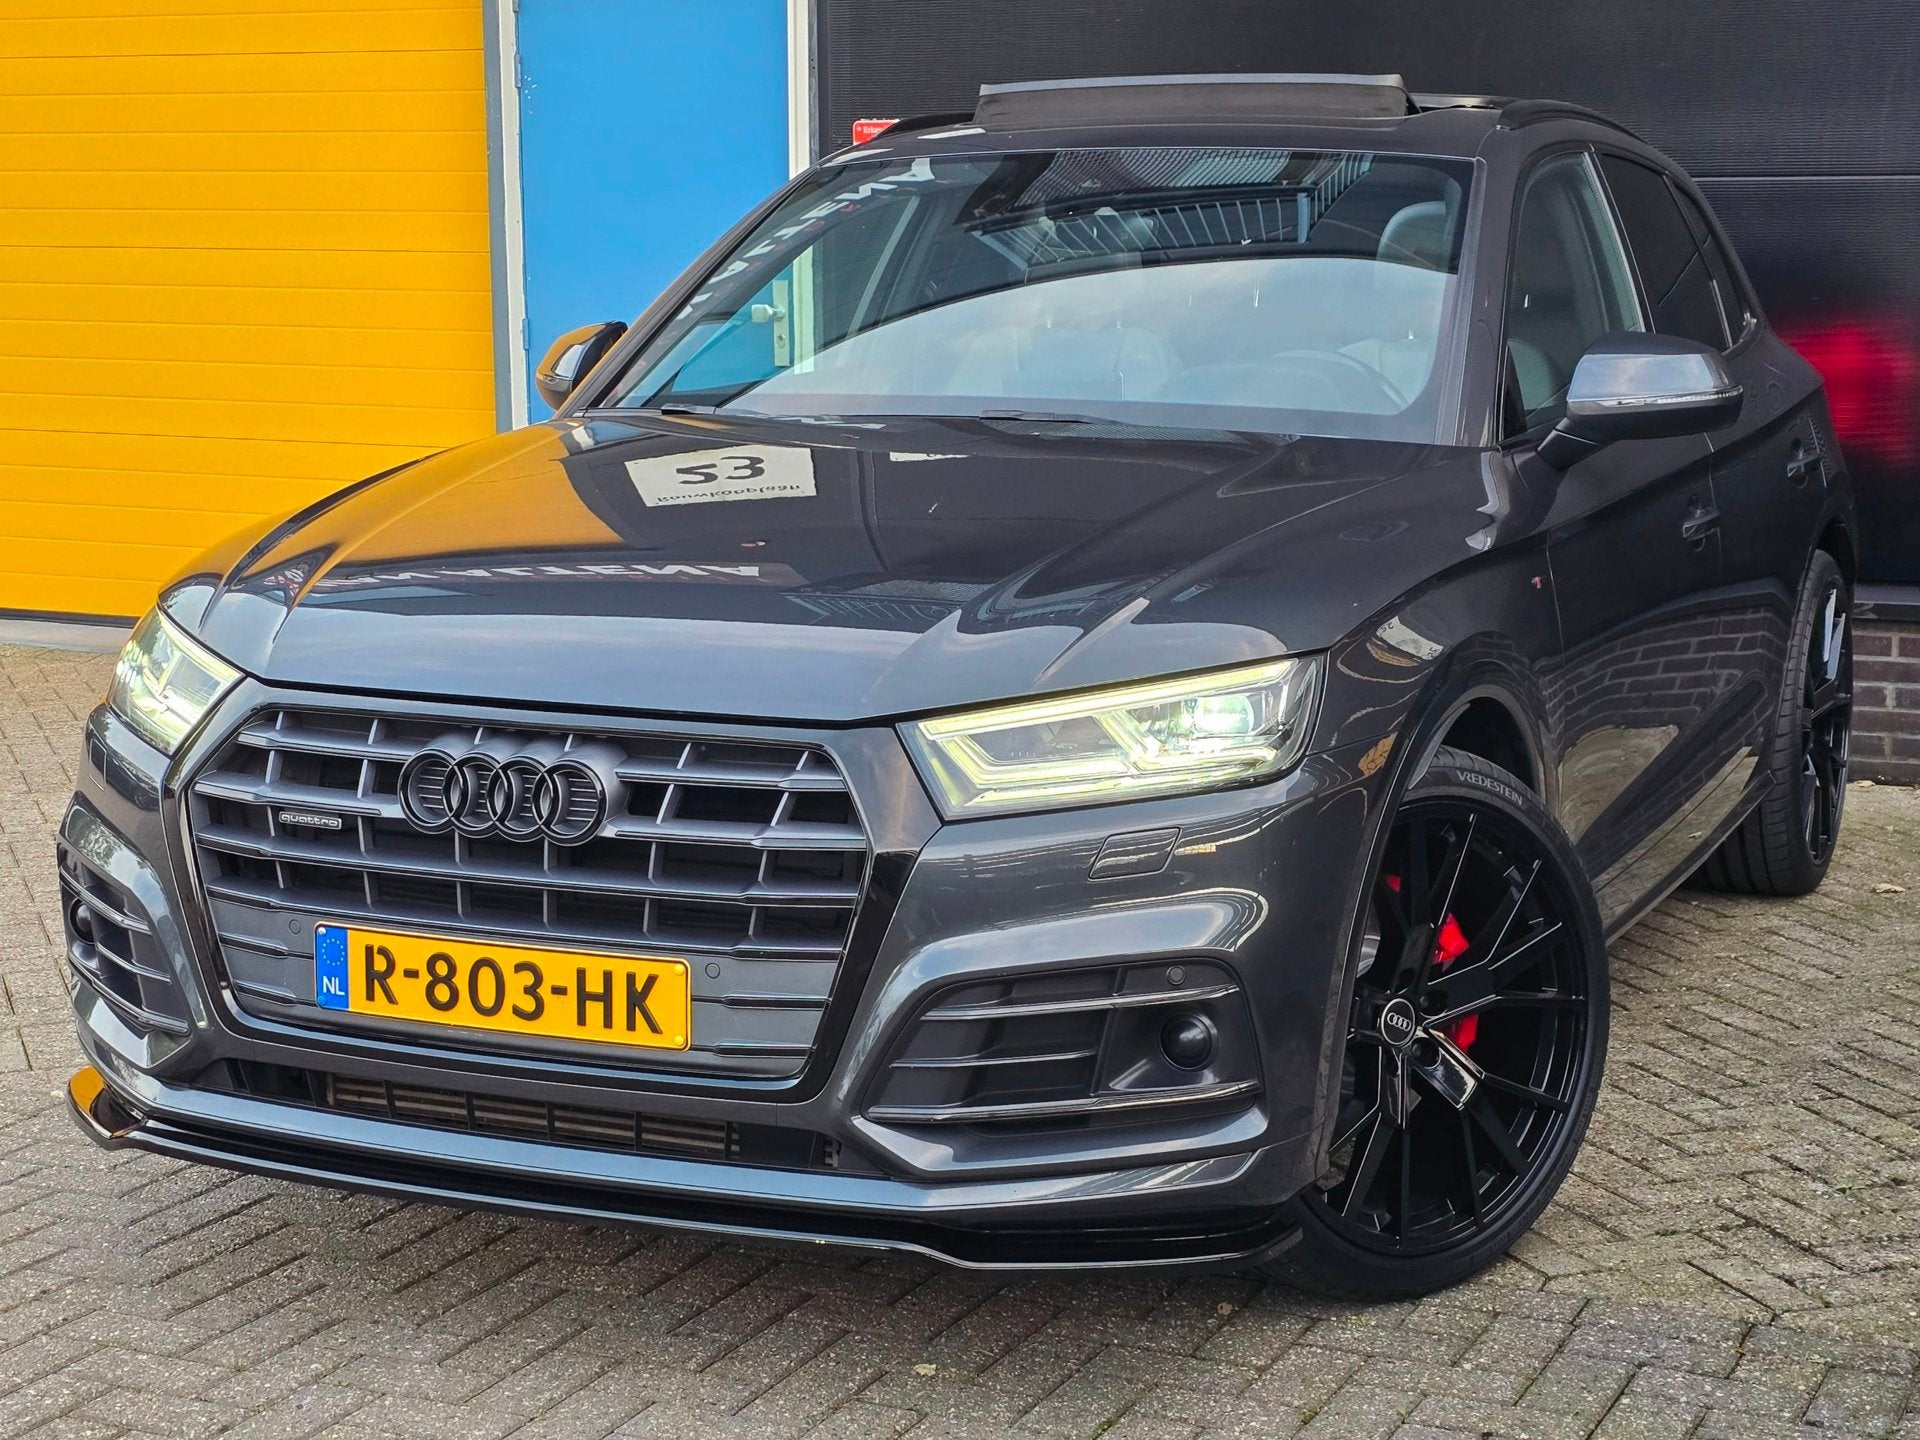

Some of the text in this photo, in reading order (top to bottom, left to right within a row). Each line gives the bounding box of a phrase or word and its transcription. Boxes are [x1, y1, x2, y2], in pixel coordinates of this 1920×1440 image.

[1456, 770, 1523, 806] VREDESTEIN
[281, 813, 338, 827] quattro
[322, 976, 345, 996] NL
[364, 943, 664, 1035] R-803-HK
